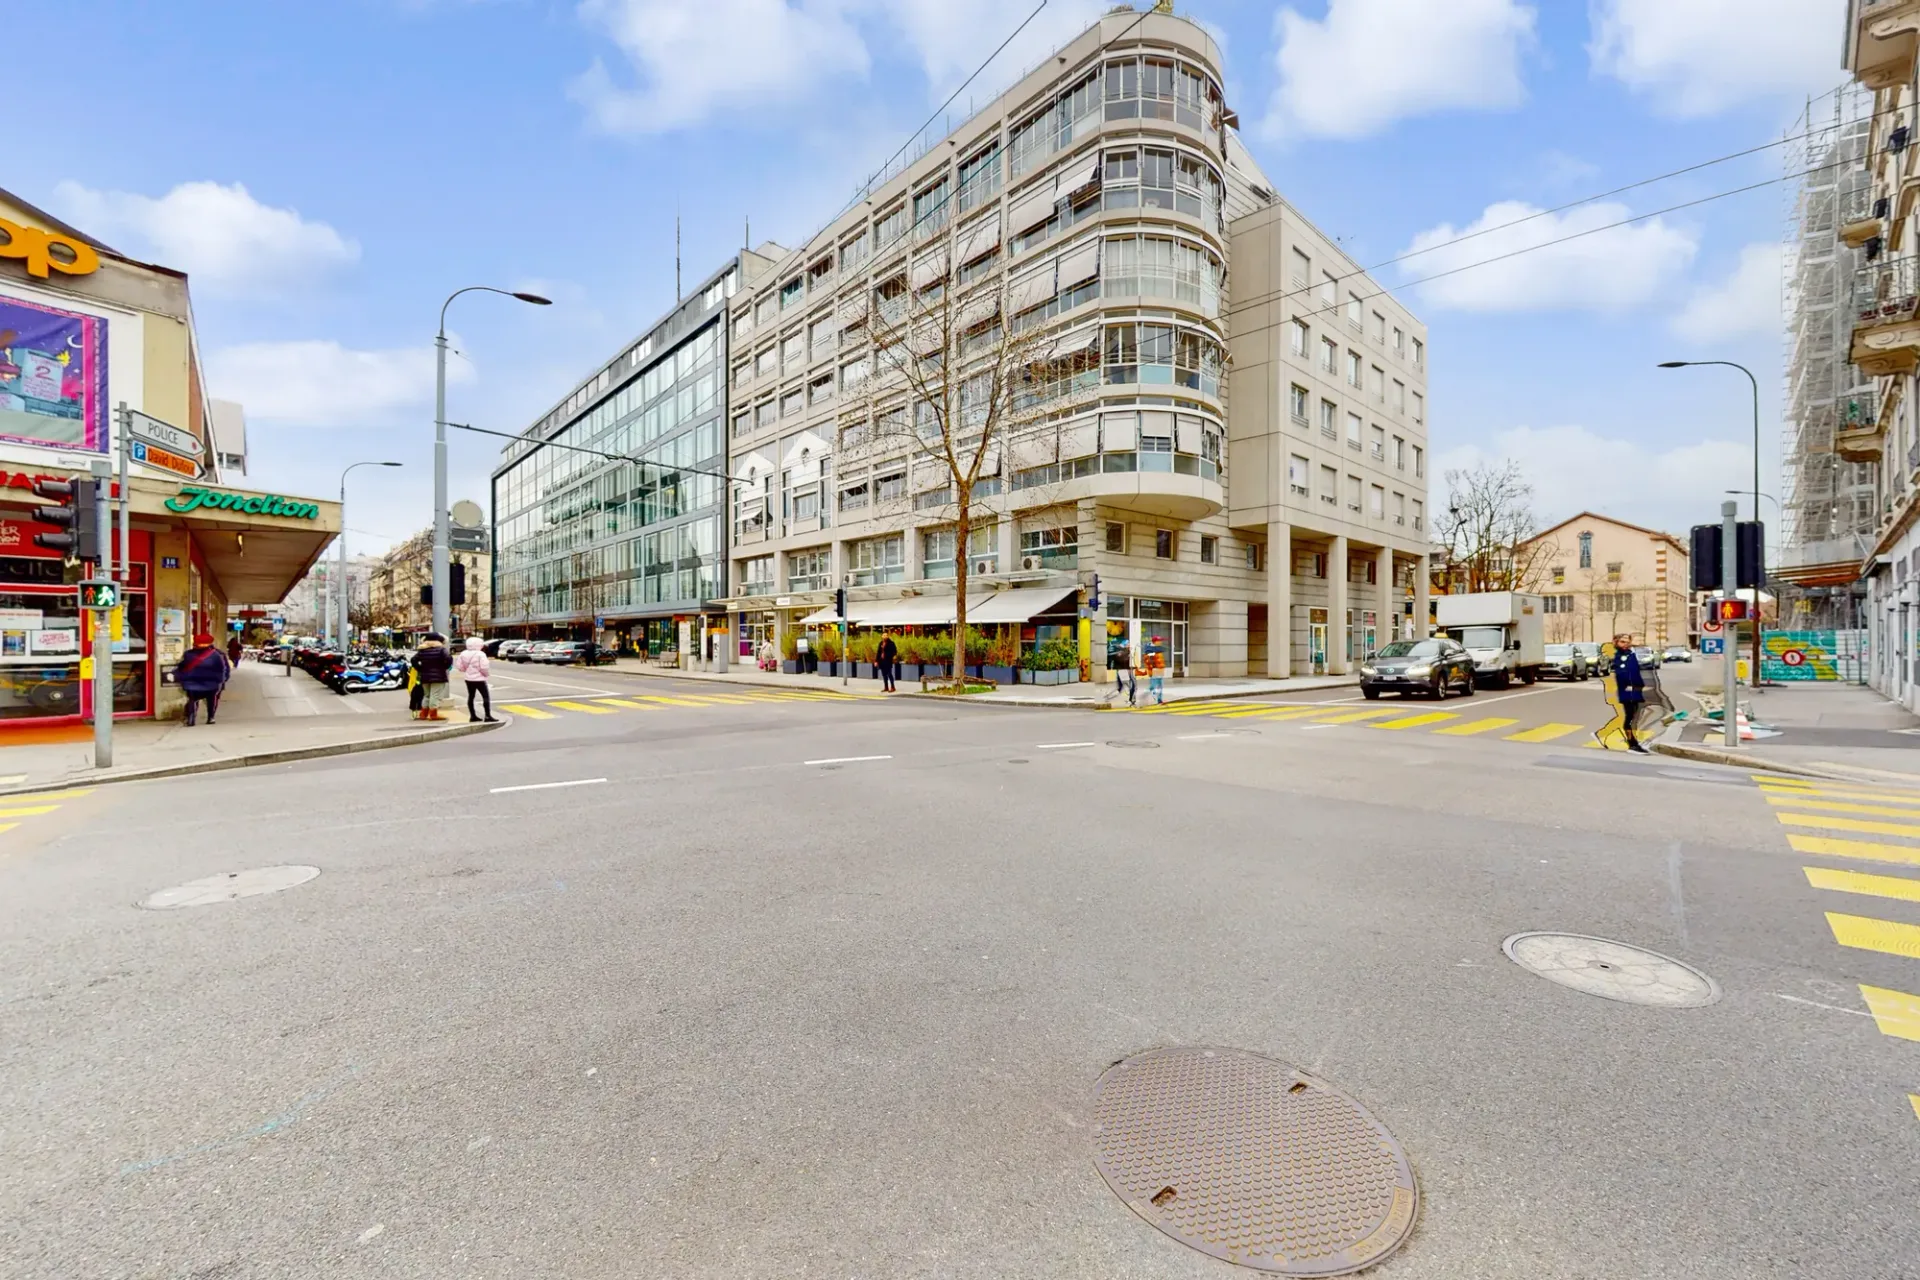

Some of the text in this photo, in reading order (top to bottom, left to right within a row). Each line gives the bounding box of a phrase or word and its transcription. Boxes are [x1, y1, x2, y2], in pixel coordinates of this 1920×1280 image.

[35, 365, 55, 381] 2
[148, 422, 178, 445] POLICE
[148, 448, 168, 467] David
[164, 487, 319, 520] Jonction
[1705, 640, 1717, 652] P
